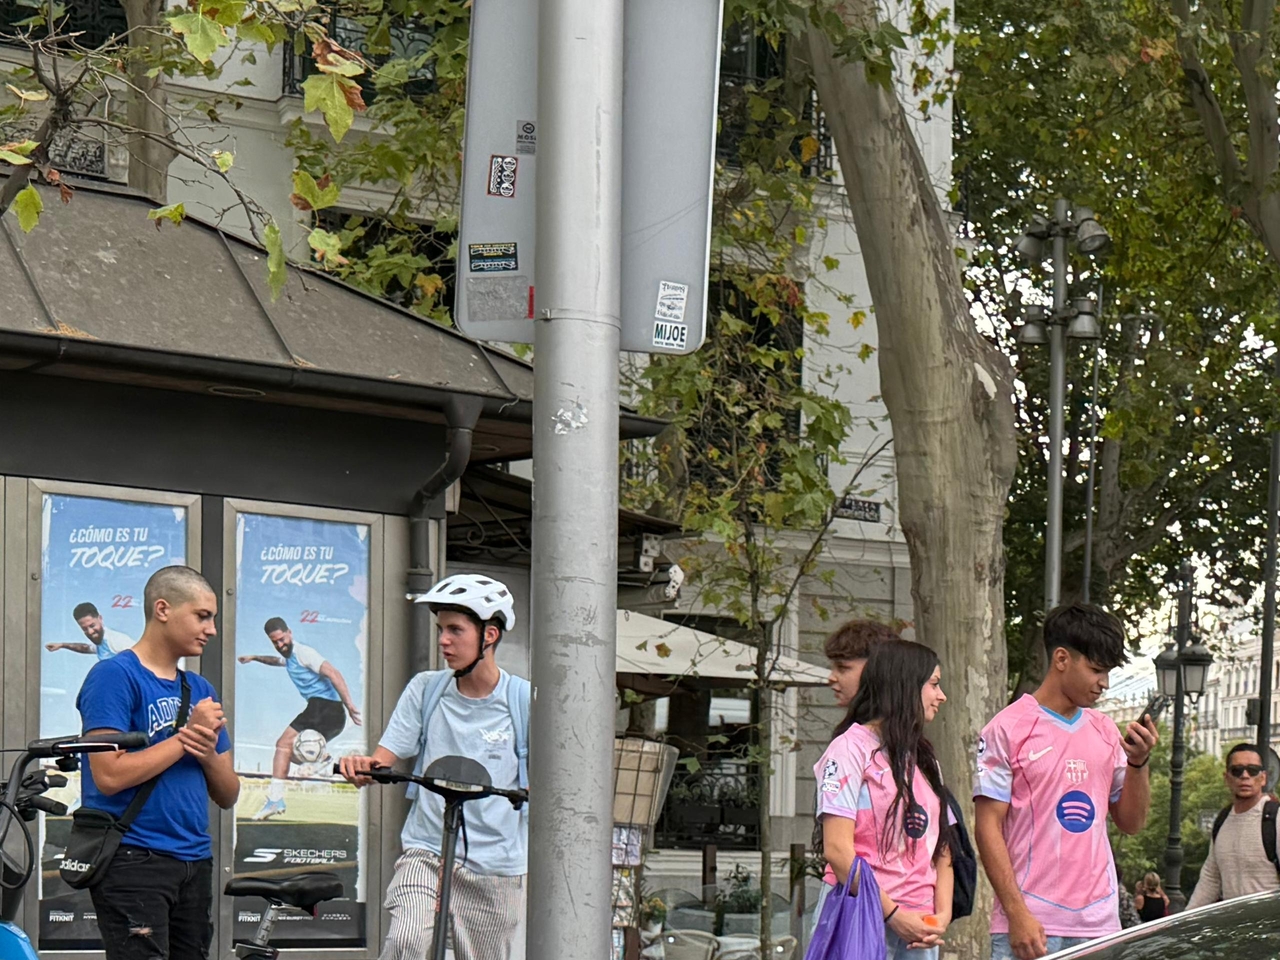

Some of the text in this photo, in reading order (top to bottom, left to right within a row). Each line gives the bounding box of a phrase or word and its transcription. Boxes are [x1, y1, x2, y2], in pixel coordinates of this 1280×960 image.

[654, 323, 686, 343] MIJOE
[69, 525, 149, 543] ¿CÓMO ES TU
[69, 545, 165, 570] TOQUE?
[260, 543, 335, 561] ¿CÓMO ES TU
[260, 563, 349, 586] TOQUE?
[111, 595, 134, 609] 22
[300, 610, 320, 624] 22
[283, 848, 348, 859] SKECHERS
